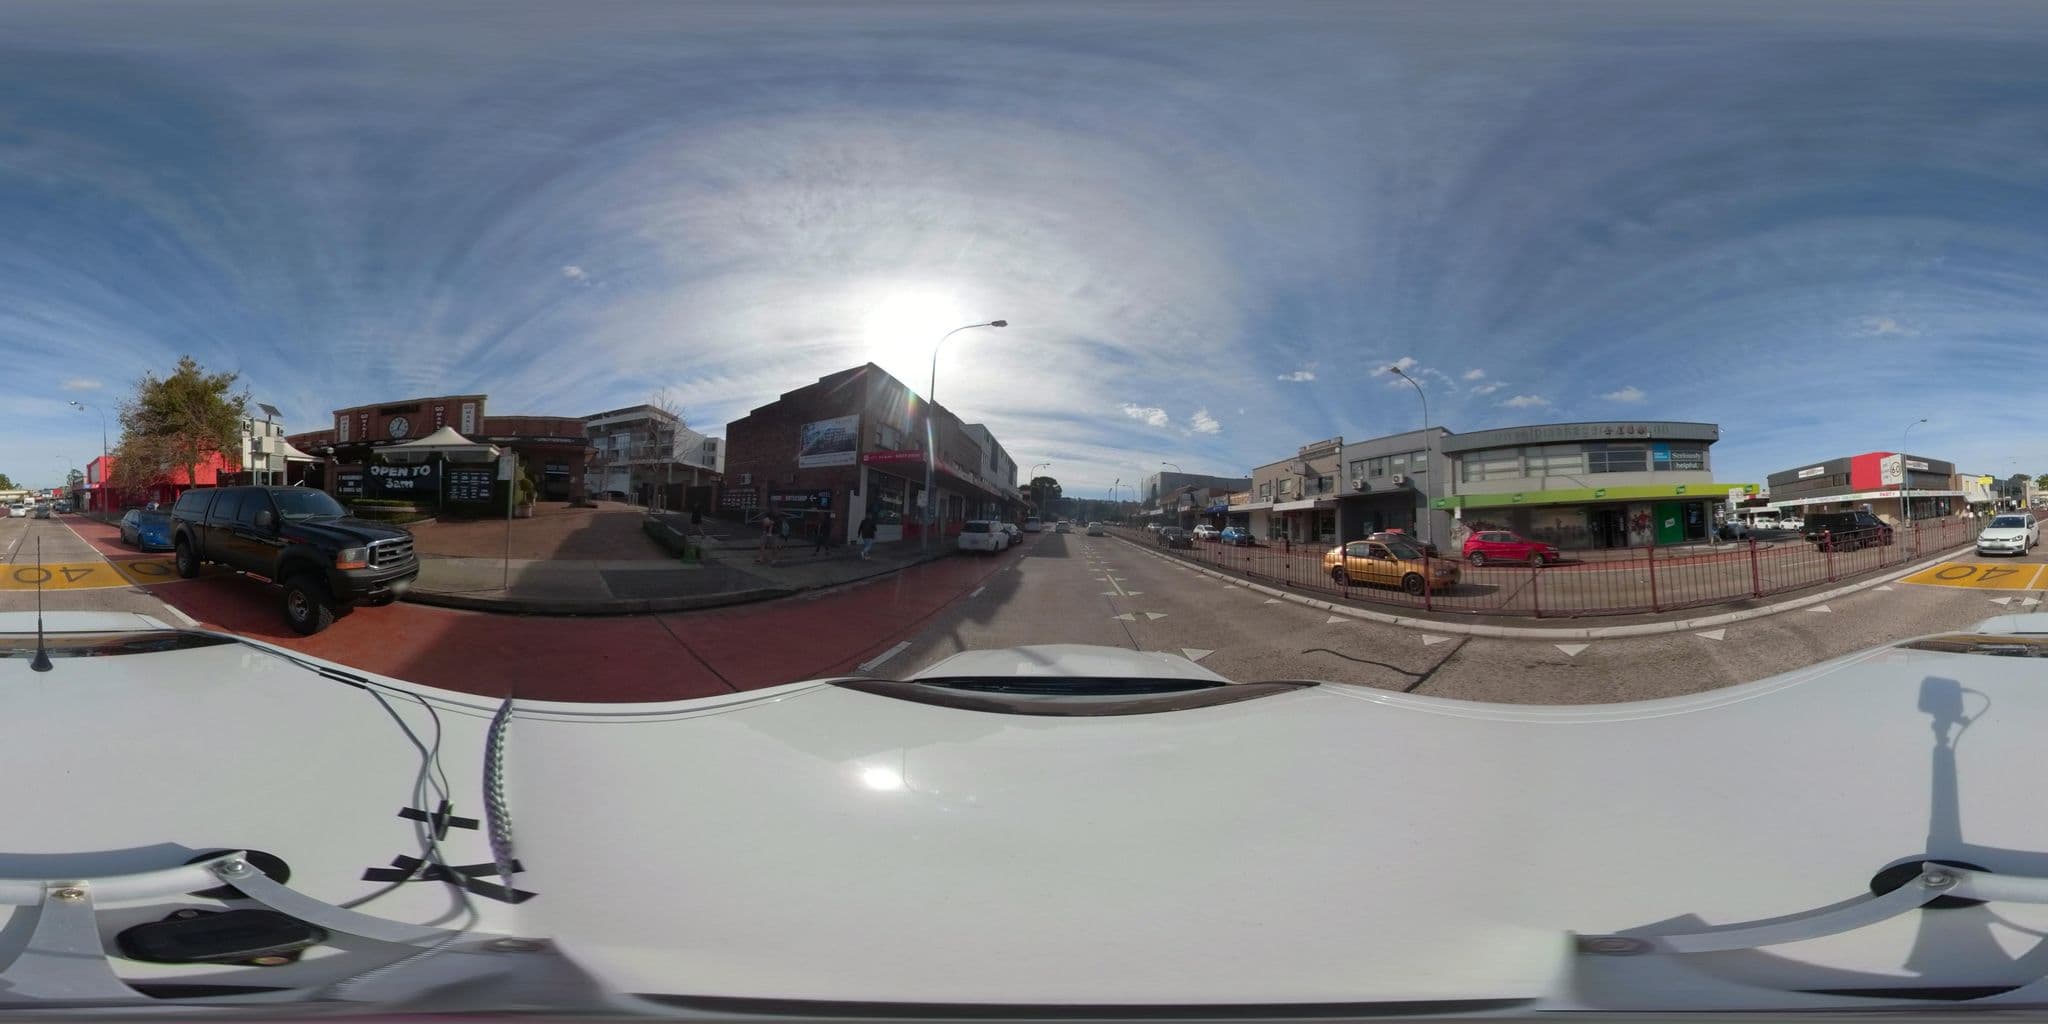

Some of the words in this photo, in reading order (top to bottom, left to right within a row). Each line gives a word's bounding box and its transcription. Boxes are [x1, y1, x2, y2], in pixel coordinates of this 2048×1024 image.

[370, 465, 408, 476] OPEN
[412, 465, 431, 476] TO
[385, 478, 414, 489] 3am
[13, 566, 94, 584] 40
[1935, 565, 2019, 582] 40
